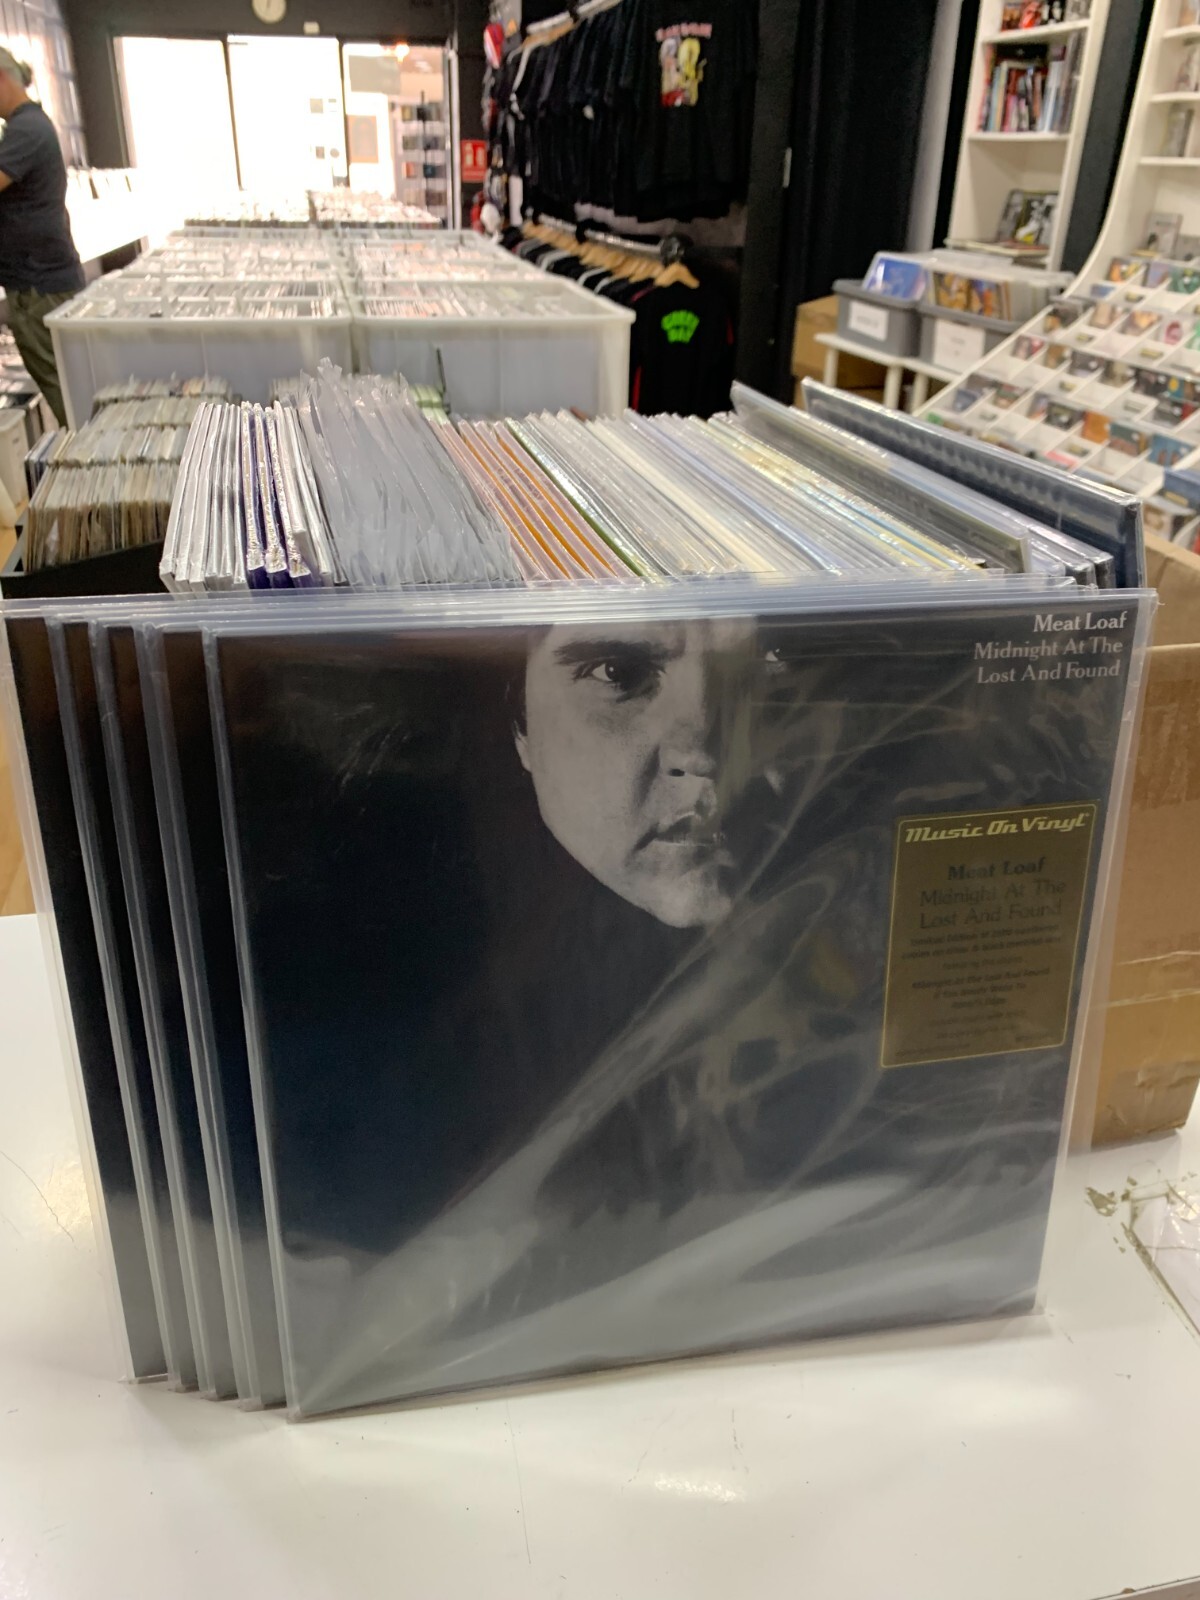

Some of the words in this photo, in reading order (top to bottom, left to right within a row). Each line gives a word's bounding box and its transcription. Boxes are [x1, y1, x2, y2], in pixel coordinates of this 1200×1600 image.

[1033, 613, 1081, 632] Meat
[1084, 611, 1128, 630] Loaf
[974, 640, 1058, 661] Midnight
[1062, 638, 1085, 655] At
[1089, 636, 1123, 653] The
[976, 666, 1015, 684] Lost
[1020, 662, 1062, 681] And
[1065, 659, 1121, 679] Found
[905, 823, 984, 843] Music
[987, 818, 1018, 836] On
[1022, 812, 1087, 832] Vinyl
[948, 862, 996, 880] Meat
[1003, 856, 1046, 875] Loaf
[919, 884, 998, 907] Midnight
[1005, 881, 1026, 898] At
[1033, 877, 1067, 895] The
[919, 911, 957, 929] Lost
[964, 906, 1002, 925] And
[1008, 897, 1063, 919] Found
